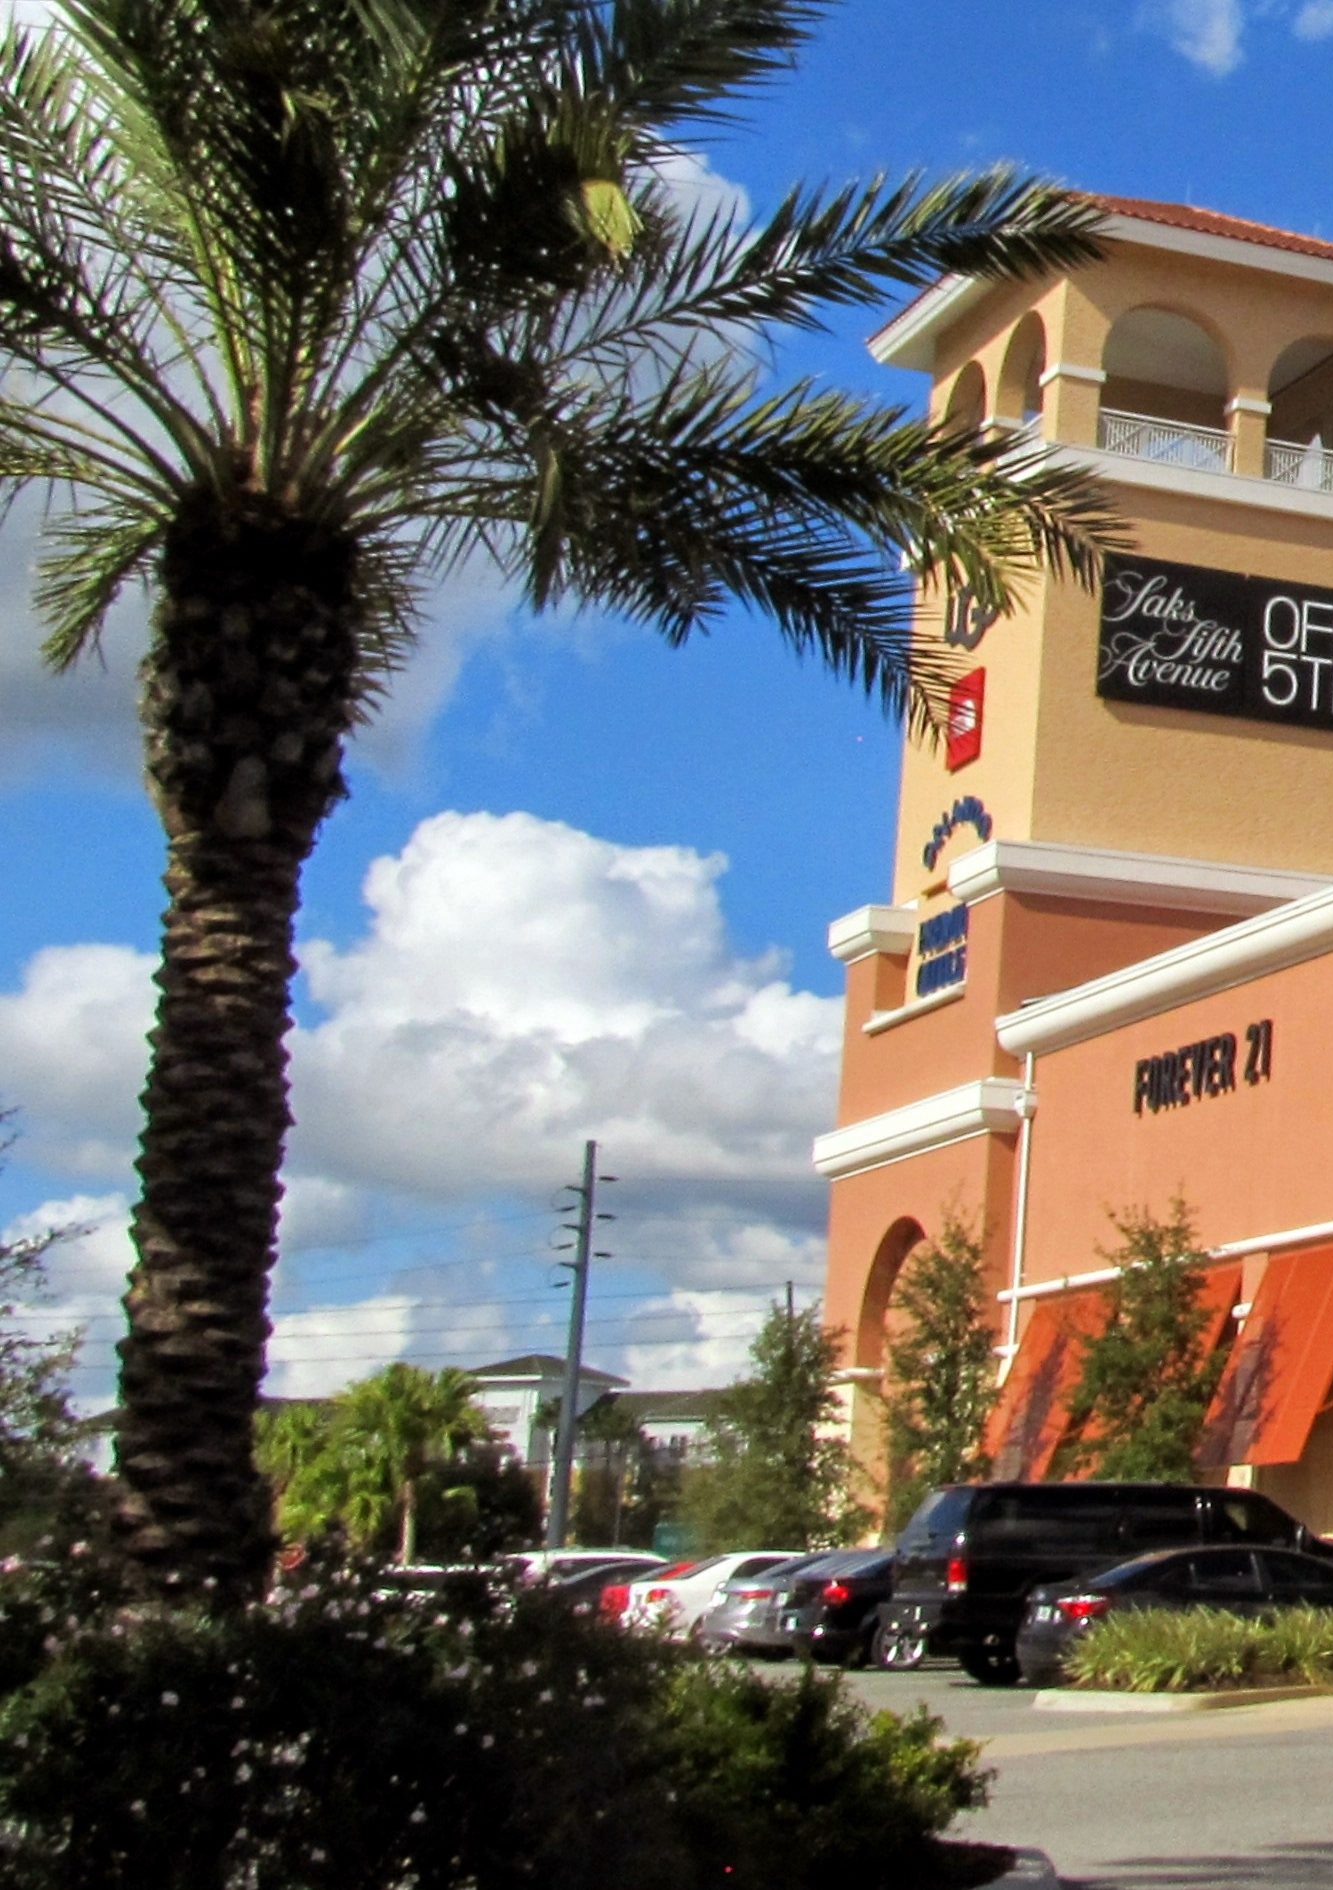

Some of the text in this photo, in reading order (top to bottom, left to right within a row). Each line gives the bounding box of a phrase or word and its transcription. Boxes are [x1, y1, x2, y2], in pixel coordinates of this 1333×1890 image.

[1102, 571, 1198, 622] Saks
[1099, 632, 1231, 691] Avenue
[1150, 615, 1244, 664] Fifth
[1133, 1019, 1273, 1118] FOREVER 21
